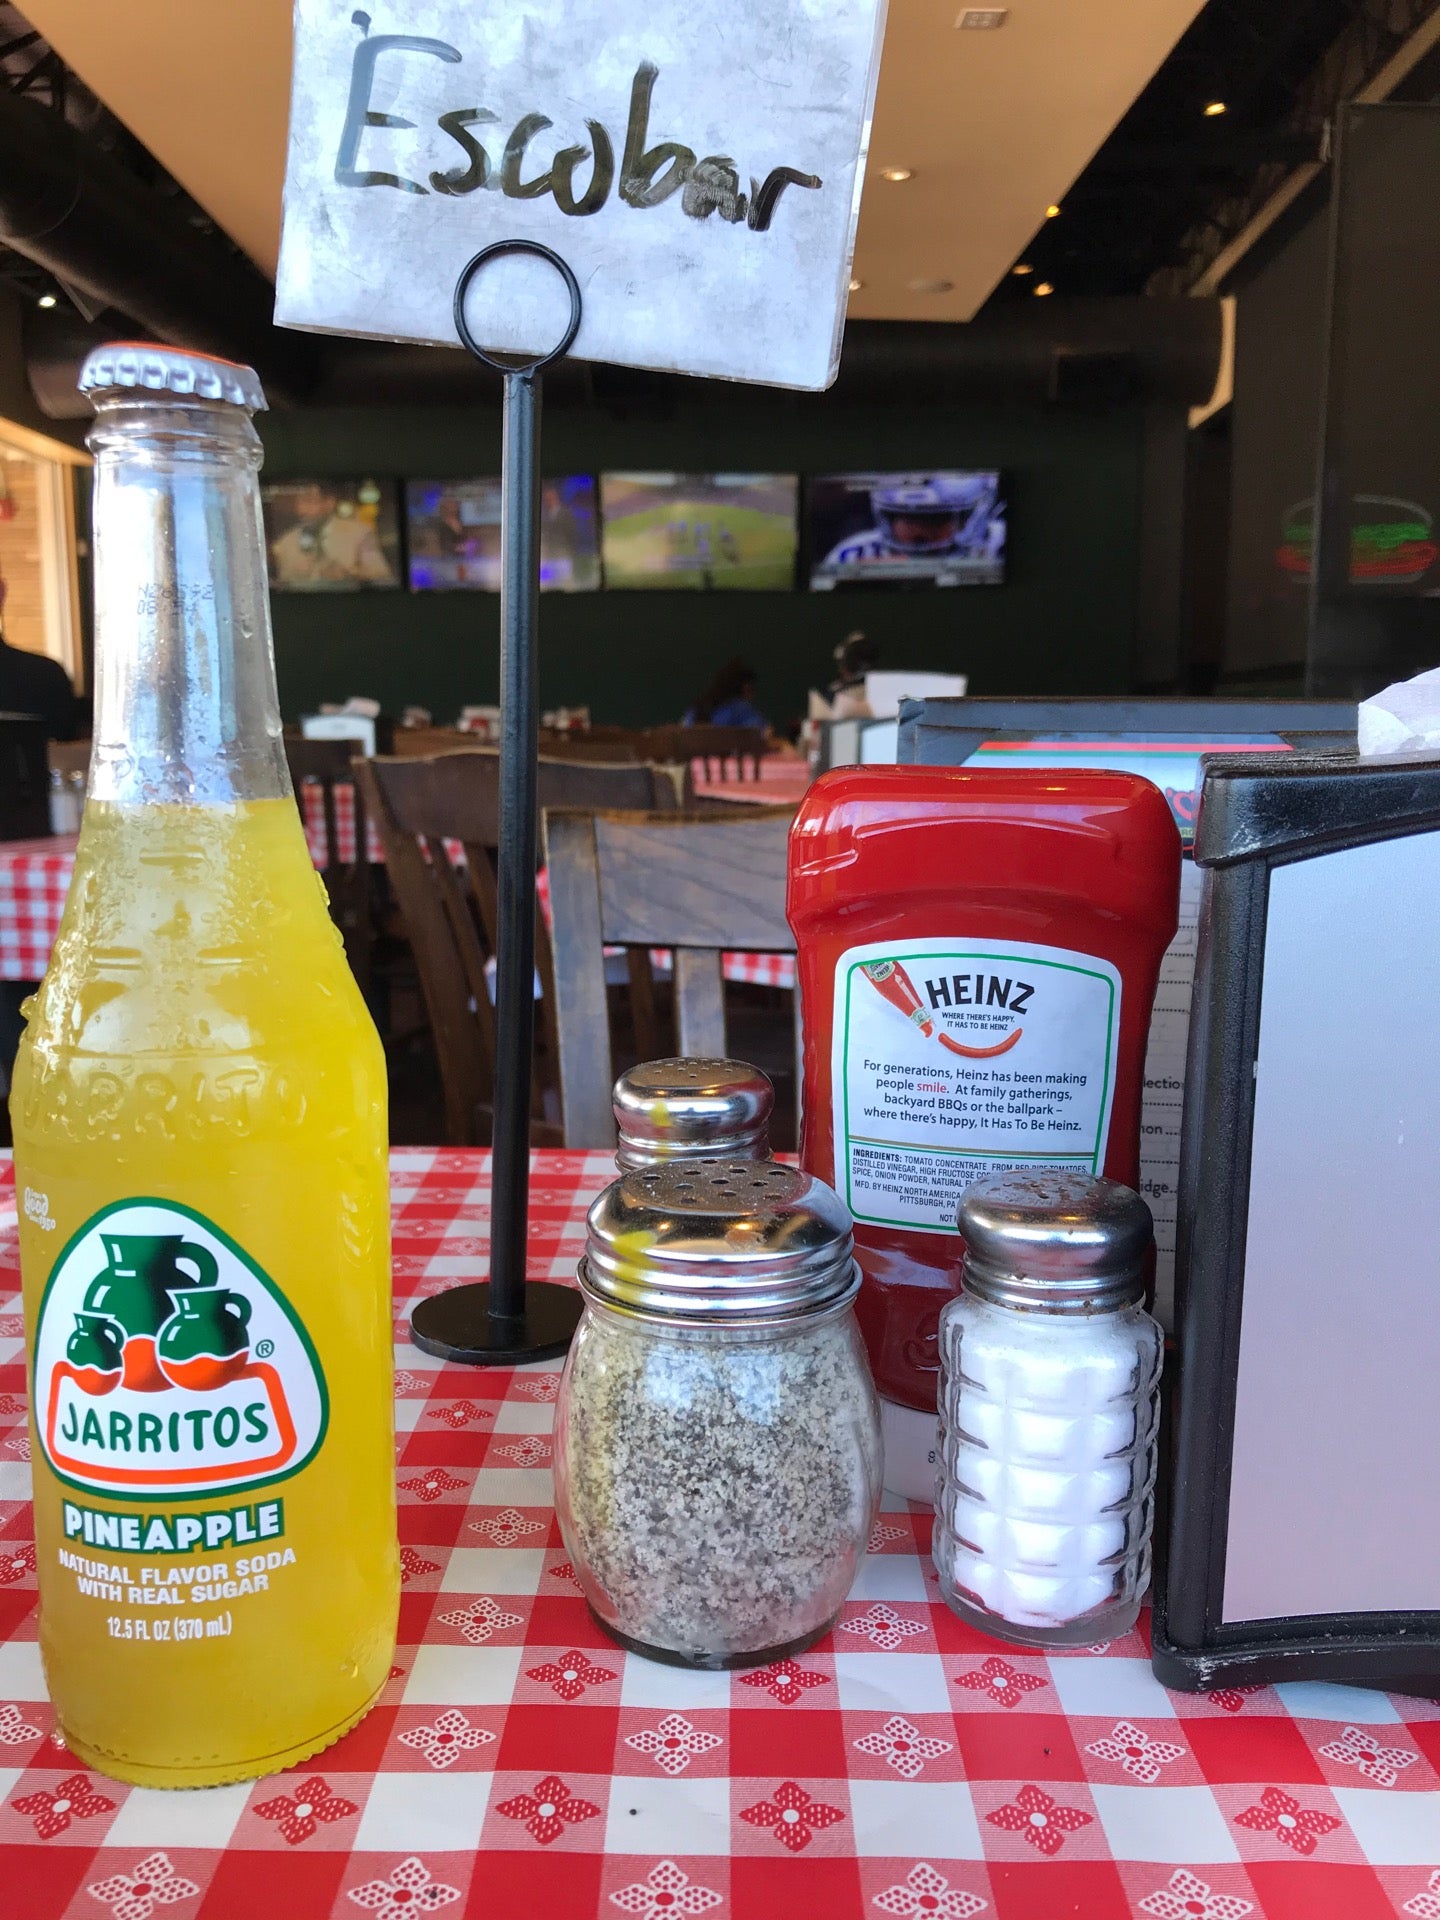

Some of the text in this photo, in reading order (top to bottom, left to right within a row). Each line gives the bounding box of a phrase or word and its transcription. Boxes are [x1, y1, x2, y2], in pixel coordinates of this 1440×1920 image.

[334, 10, 824, 232] Escobar
[925, 974, 1035, 1015] HEINZ
[942, 1012, 964, 1020] WHERE
[967, 1013, 991, 1021] THERE'S
[955, 1021, 968, 1029] HAS
[990, 1023, 1008, 1031] HEINZ
[864, 1059, 1087, 1086] For generations, Heinz has been making
[876, 1077, 1073, 1101] people smile. At family gatherings,
[884, 1092, 935, 1108] backyard
[938, 1098, 968, 1112] BBQs
[970, 1103, 983, 1112] or
[985, 1102, 1004, 1113] the
[1007, 1101, 1054, 1116] ballpark
[864, 1106, 897, 1120] where
[939, 1114, 978, 1129] happy,
[980, 1117, 989, 1128] It
[992, 1118, 1012, 1129] Has
[1014, 1118, 1027, 1130] To
[1031, 1119, 1045, 1131] Be
[1047, 1119, 1082, 1131] Heinz.
[853, 1148, 902, 1162] INGREDIENTS:
[904, 1155, 933, 1166] TOMATO
[935, 1158, 987, 1171] CONCENTRATE
[991, 1163, 1012, 1172] FROM
[853, 1157, 885, 1169] DISTILLED
[887, 1162, 917, 1174] VINEGAR,
[920, 1166, 937, 1176] HIGH
[938, 1168, 974, 1179] FRUCTOSE
[852, 1167, 873, 1178] SPICE,
[874, 1170, 896, 1180] ONION
[898, 1174, 930, 1185] POWDER,
[932, 1177, 963, 1188] NATURAL
[854, 1180, 961, 1199] MFD. BY HEINZ NORTH AMERICA
[899, 1195, 956, 1208] PITTSBURGH, PA
[940, 1214, 953, 1223] NOT
[61, 1401, 269, 1453] JARRITOS
[64, 1501, 282, 1551] PINEAPPLE
[58, 1548, 297, 1586] NATURAL FLAVOR SODA
[77, 1574, 269, 1605] WITH REAL SUGAR
[107, 1611, 232, 1641] 12.5 FL OZ (370 mL)
